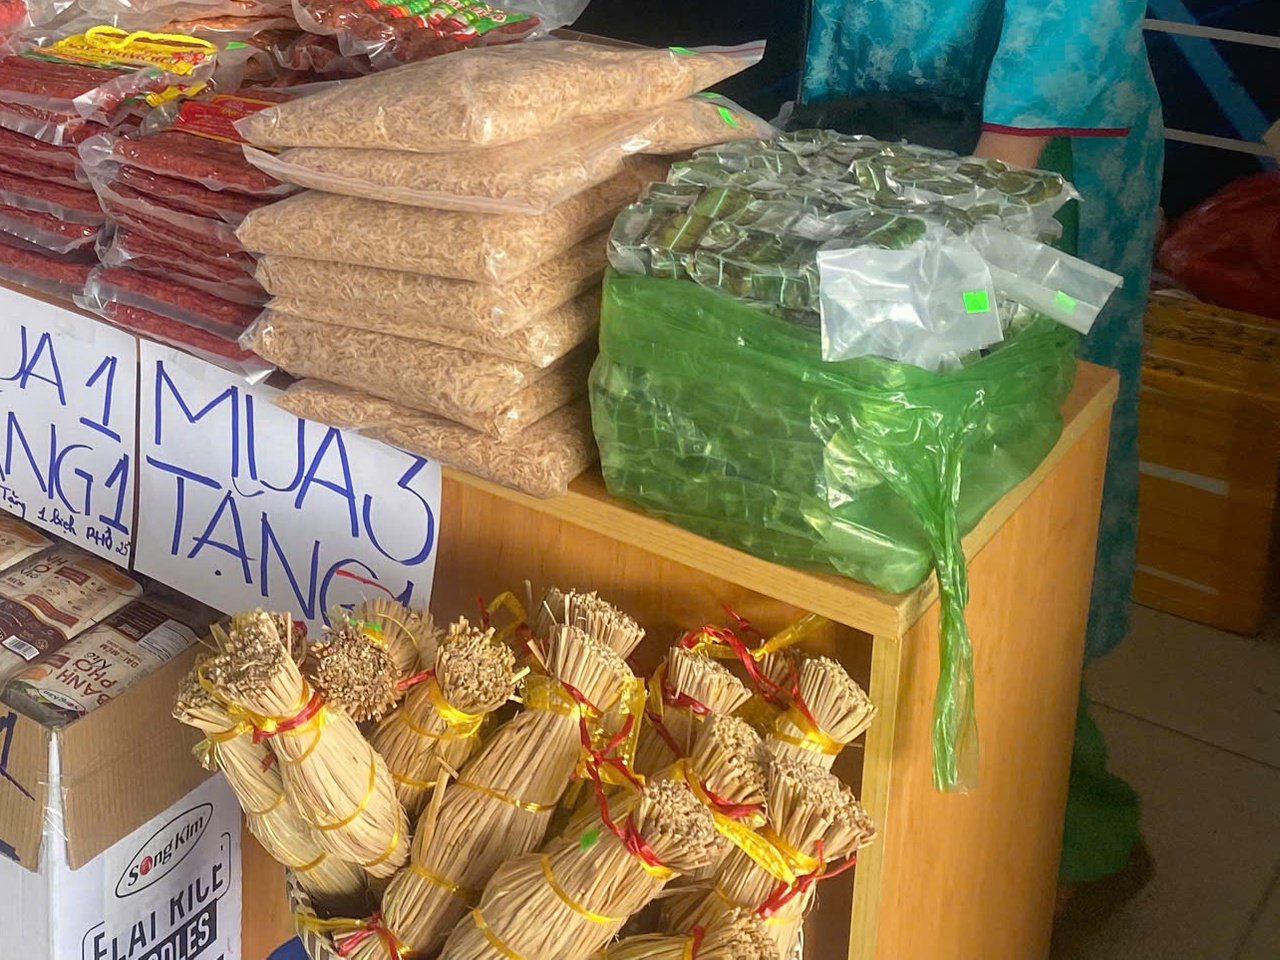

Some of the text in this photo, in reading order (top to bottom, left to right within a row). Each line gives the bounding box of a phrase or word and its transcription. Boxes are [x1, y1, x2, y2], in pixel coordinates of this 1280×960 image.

[80, 355, 122, 444] 1
[98, 452, 130, 536] 1
[154, 360, 435, 567] MUA 3
